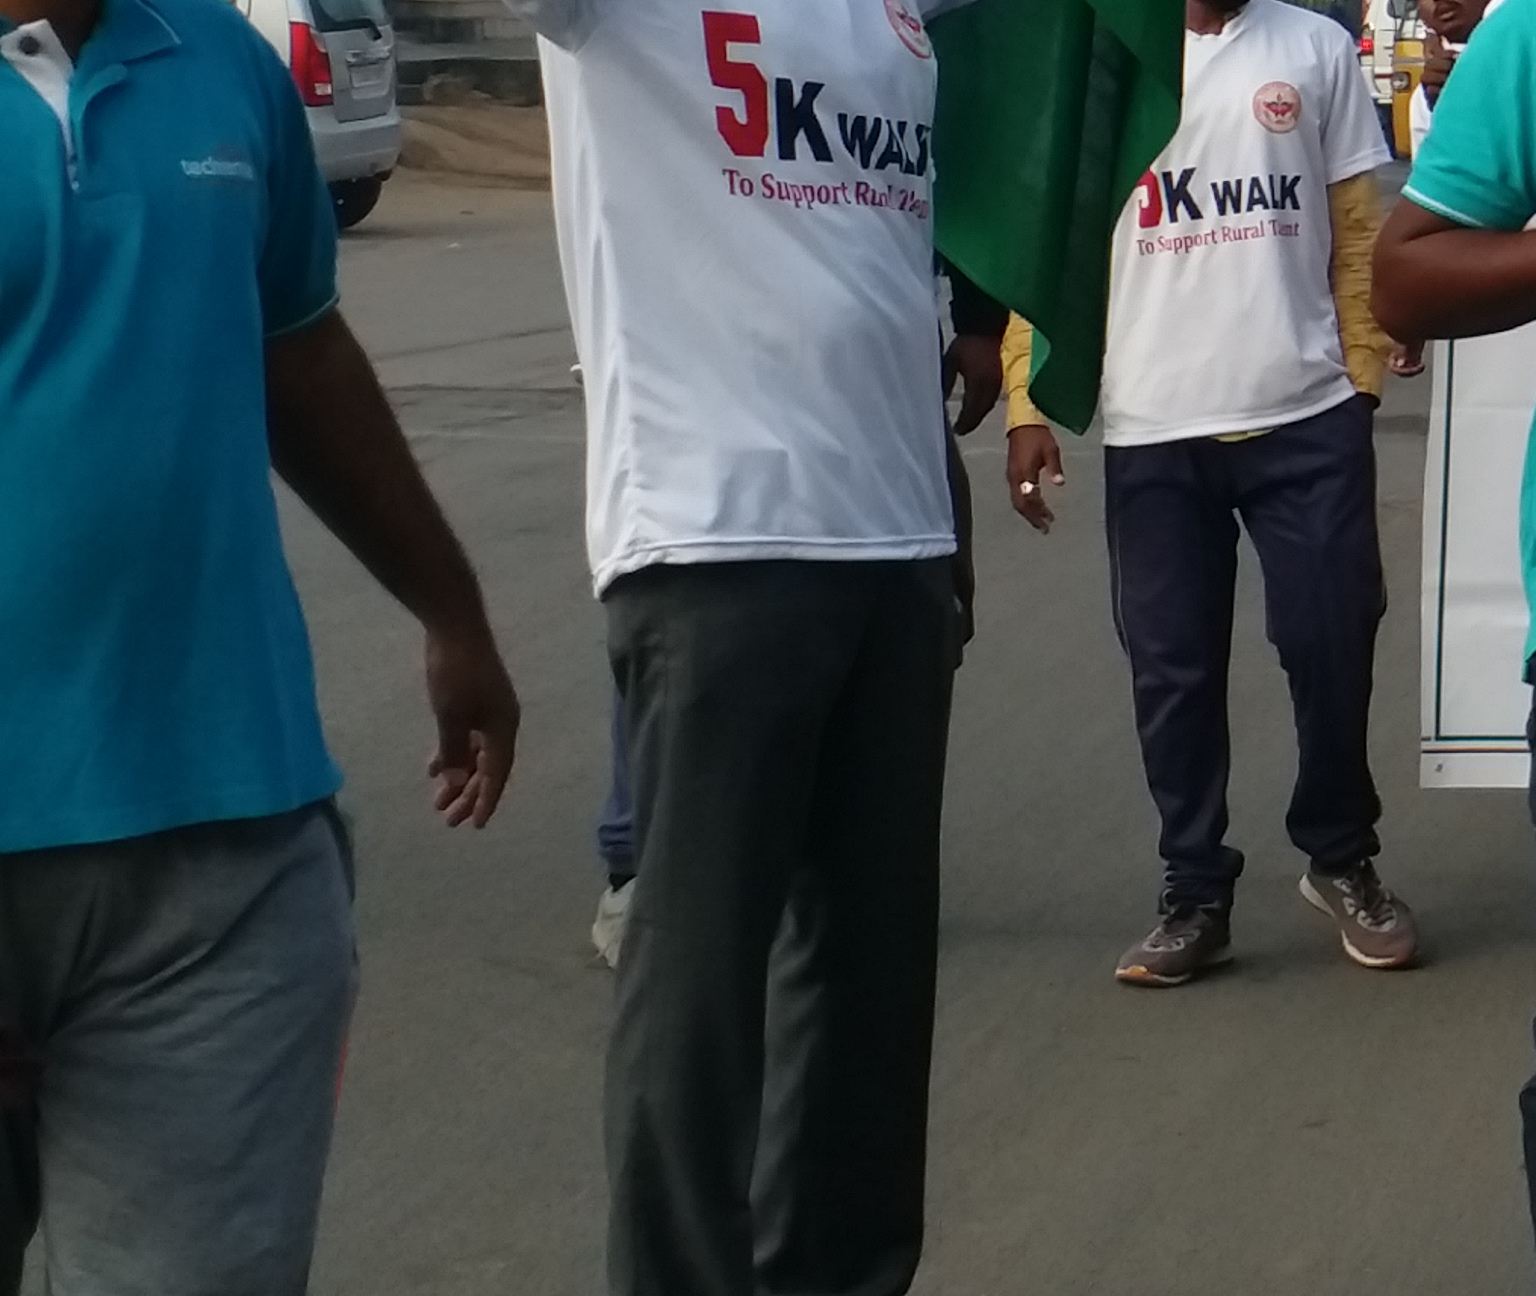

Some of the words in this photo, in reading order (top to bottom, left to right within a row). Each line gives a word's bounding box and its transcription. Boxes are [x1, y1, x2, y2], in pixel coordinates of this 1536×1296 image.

[702, 10, 834, 163] 5K
[722, 169, 754, 197] To
[761, 173, 851, 210] Support
[1210, 174, 1302, 217] WALK
[1137, 239, 1155, 256] To
[1221, 220, 1265, 242] Rural
